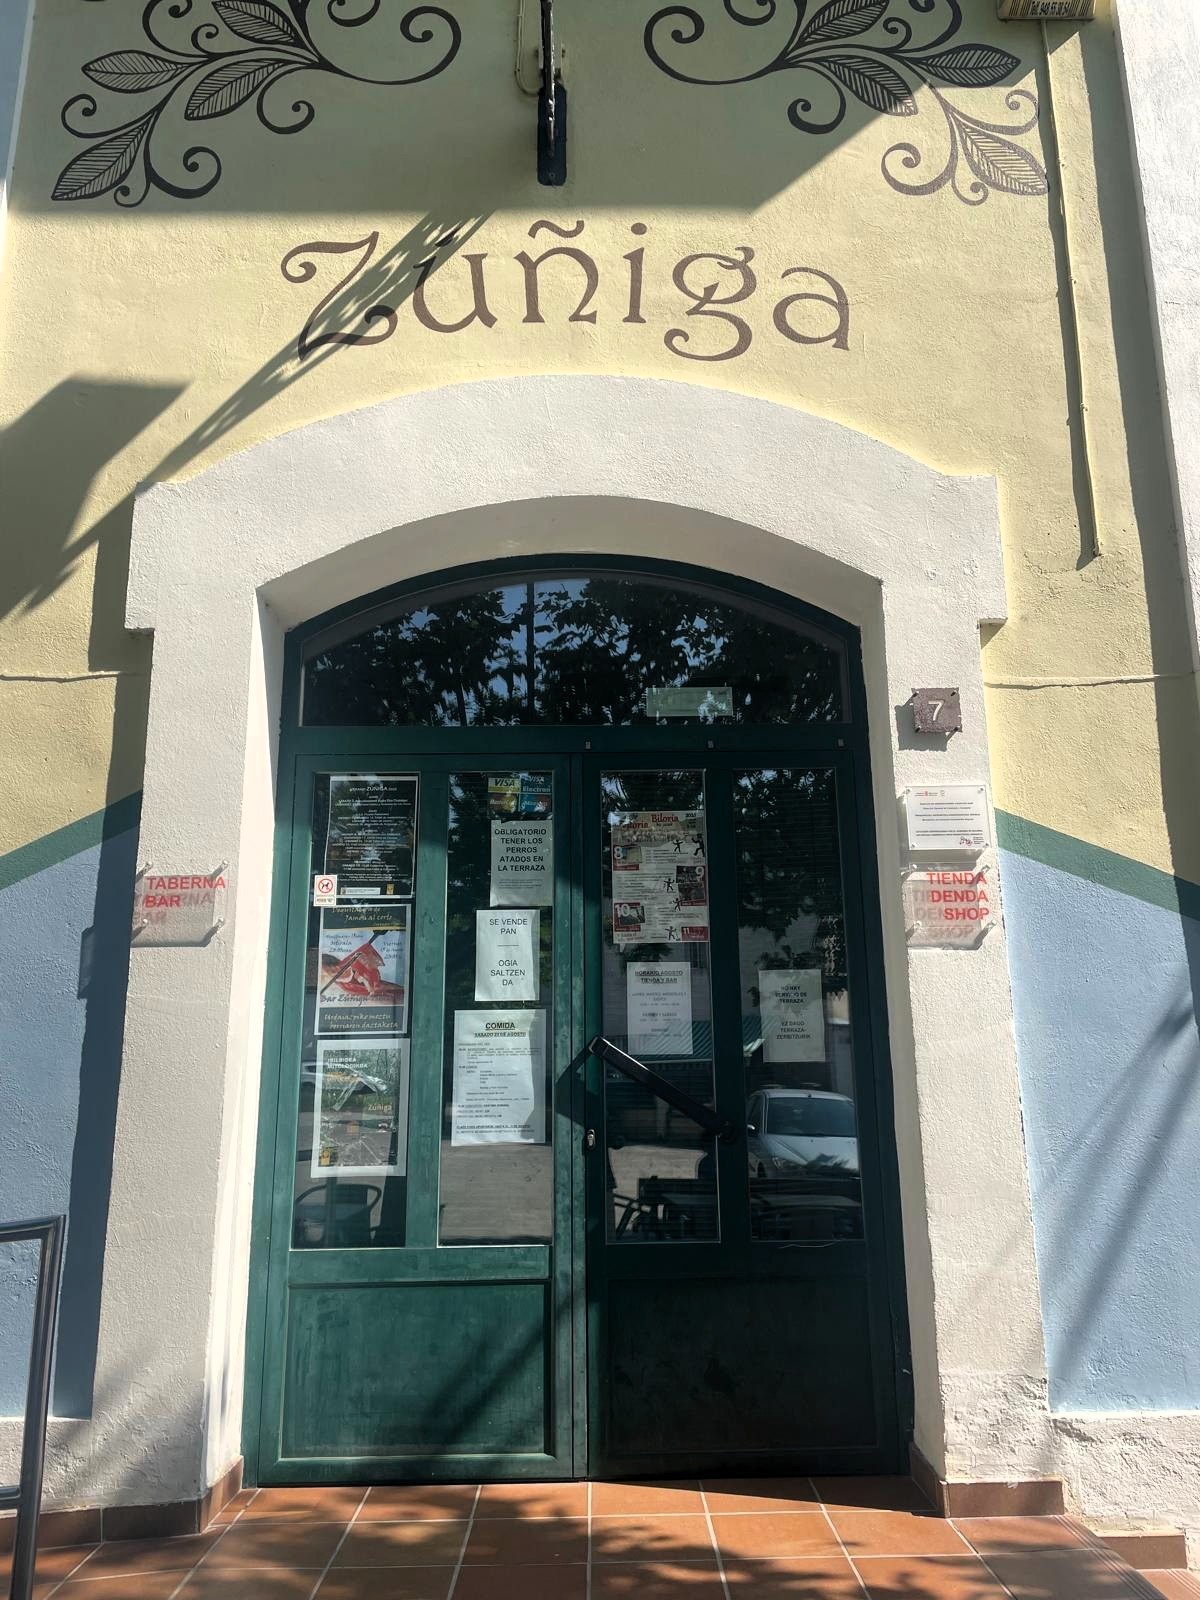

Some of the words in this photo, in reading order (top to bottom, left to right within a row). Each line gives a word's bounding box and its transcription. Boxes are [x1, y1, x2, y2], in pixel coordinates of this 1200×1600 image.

[280, 219, 851, 362] Zúñiga
[928, 699, 945, 721] 7
[494, 778, 515, 787] VISA
[528, 775, 545, 783] VISA
[651, 813, 679, 823] Biloria
[494, 828, 547, 836] OBLIGATORIO
[500, 837, 526, 845] TENER
[506, 846, 537, 854] PERROS
[614, 846, 624, 860] 8
[499, 855, 531, 863] ATADOS
[533, 855, 544, 863] EN
[497, 864, 508, 872] LA
[510, 864, 546, 872] TERRAZA
[695, 866, 705, 878] 9
[146, 876, 226, 890] TABERNA
[927, 872, 988, 885] TIENDA
[931, 889, 989, 903] DENDA
[145, 894, 181, 908] BAR
[615, 904, 630, 918] 10
[944, 907, 990, 921] SHOP
[489, 918, 500, 926] SE
[501, 918, 528, 926] VENDE
[498, 959, 518, 967] OGIA
[490, 969, 526, 977] SALTZEN
[485, 1022, 516, 1030] COMIDA
